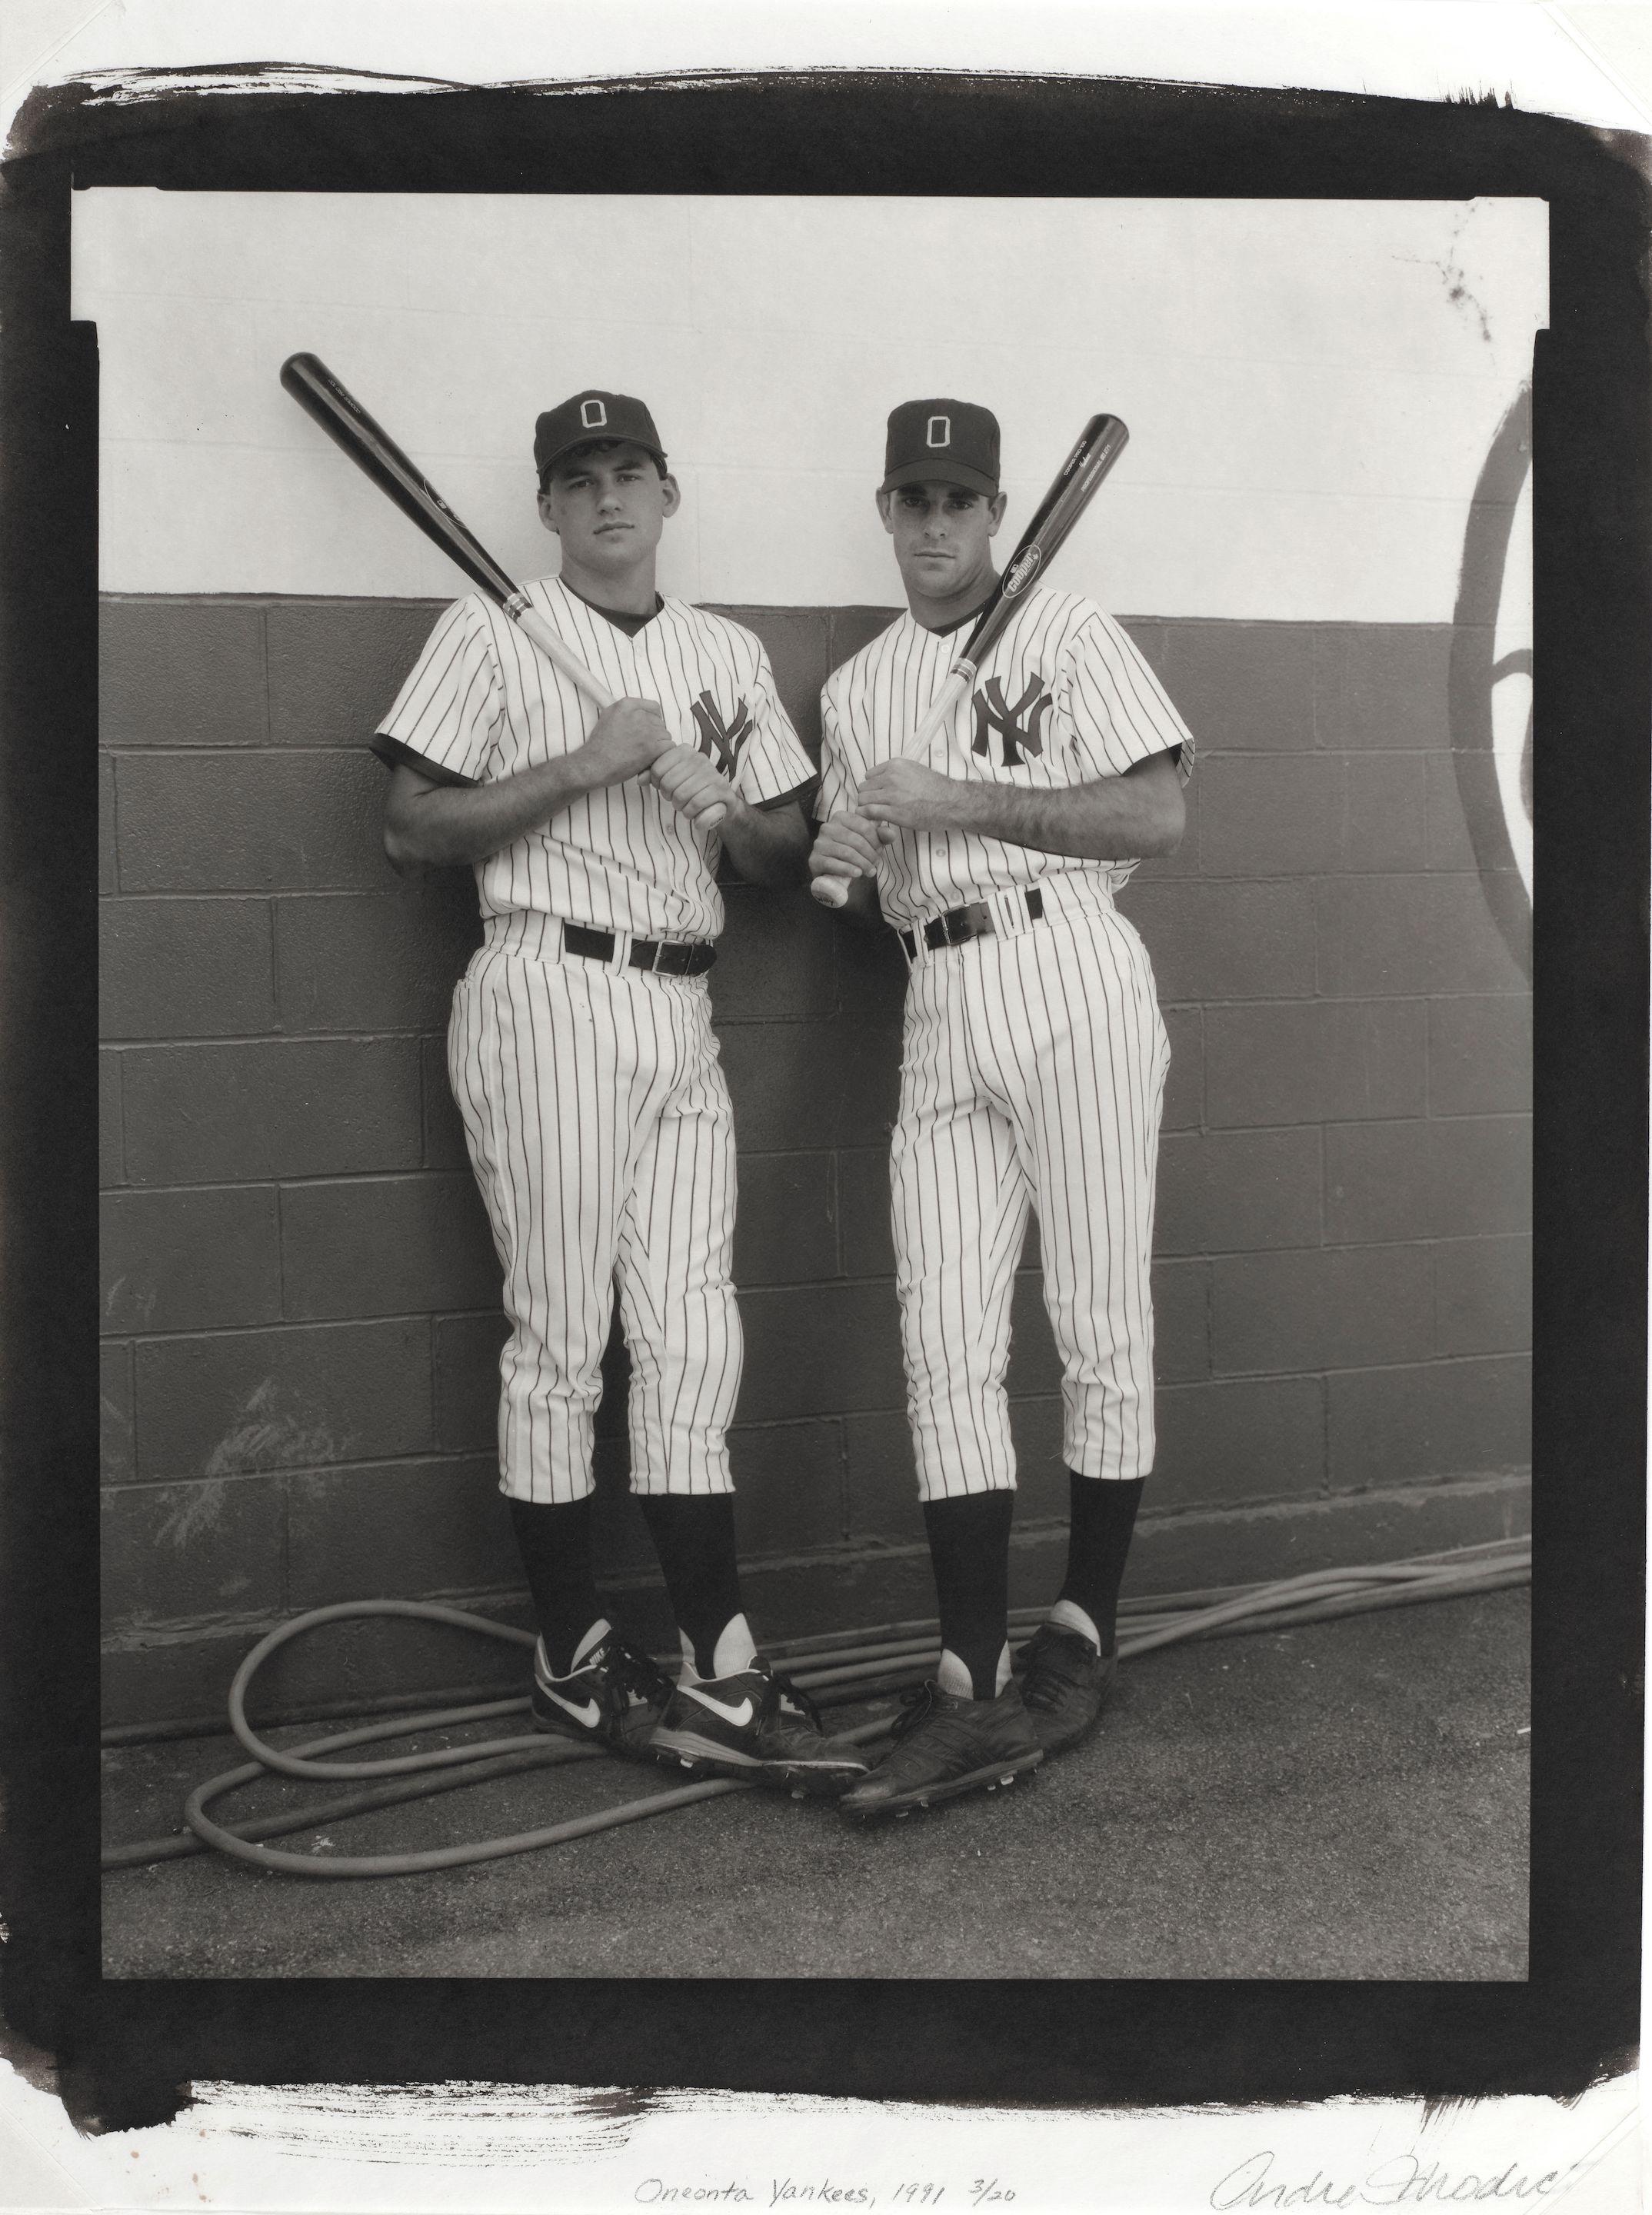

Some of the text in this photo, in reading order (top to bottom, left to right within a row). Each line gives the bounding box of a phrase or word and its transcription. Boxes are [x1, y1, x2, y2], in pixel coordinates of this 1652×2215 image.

[580, 400, 607, 428] O
[927, 416, 951, 448] O
[1008, 553, 1034, 592] Cooper
[971, 671, 1053, 767] NY
[690, 690, 753, 783] NY
[589, 1647, 605, 1666] NIKE
[634, 2177, 1016, 2208] Oneonta Yankees, 1991 3/20
